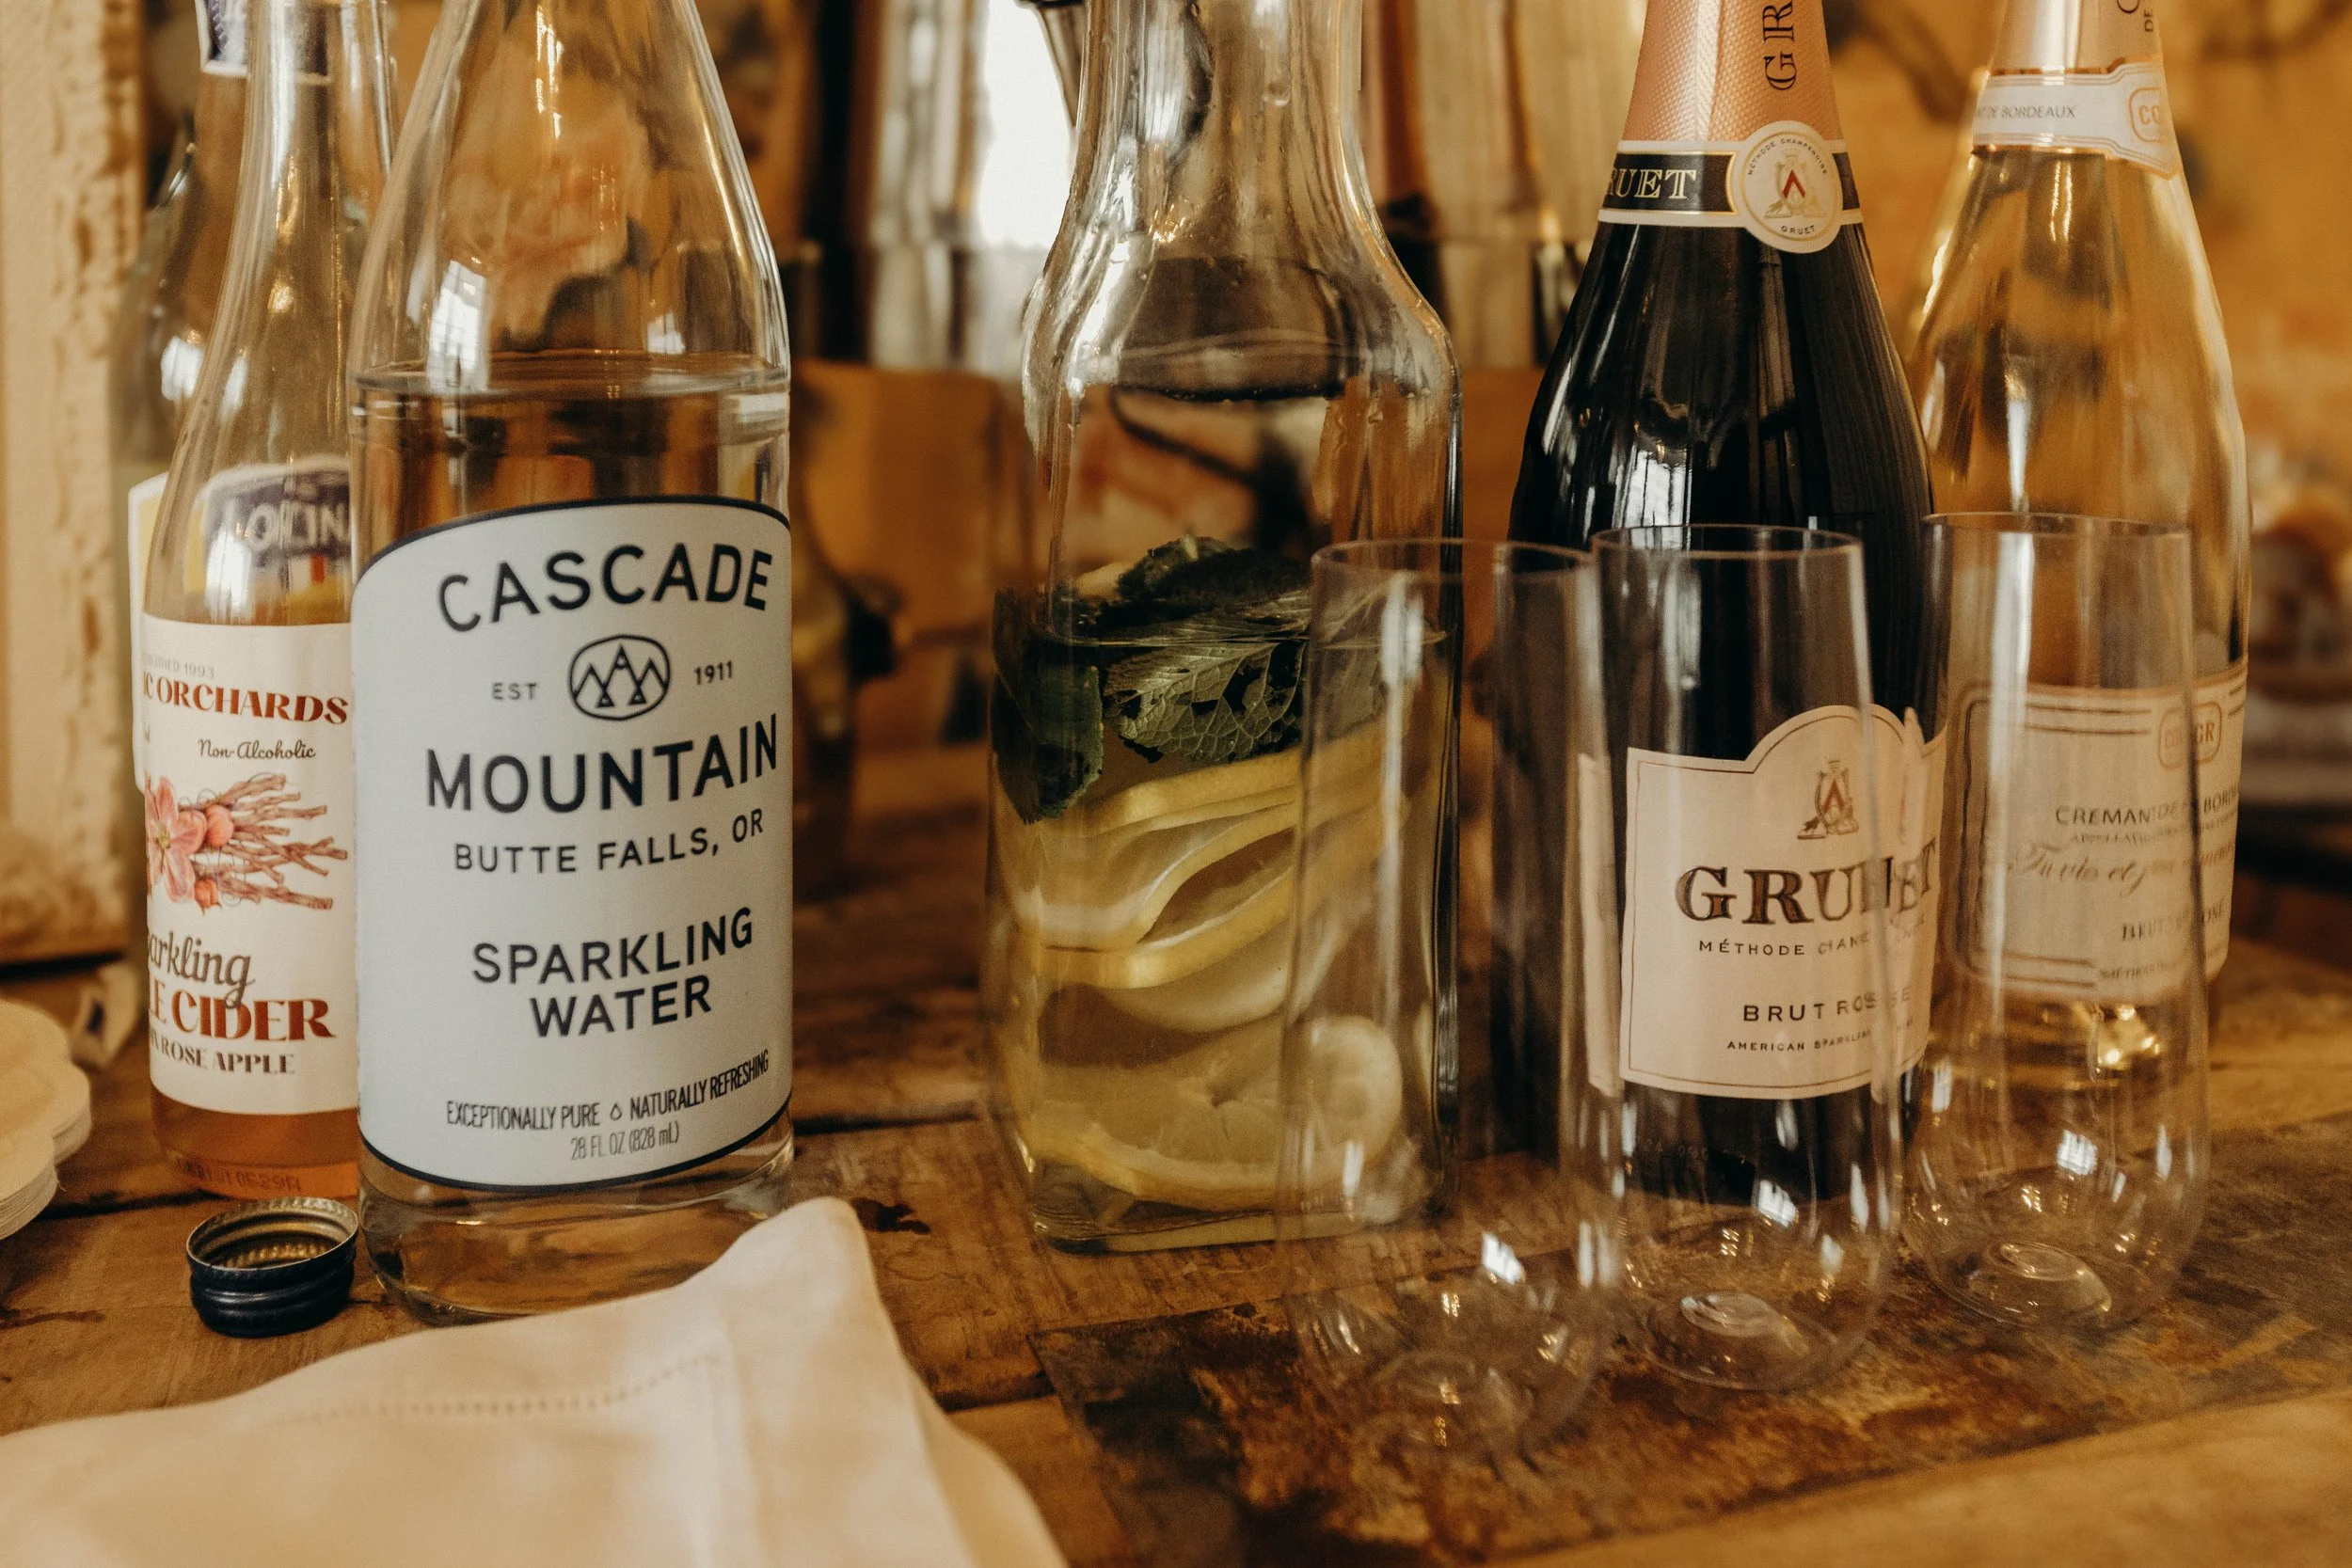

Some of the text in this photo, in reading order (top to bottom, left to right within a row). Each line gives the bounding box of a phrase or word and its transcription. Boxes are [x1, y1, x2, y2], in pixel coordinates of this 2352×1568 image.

[437, 543, 772, 632] CASCADE
[184, 661, 215, 679] 1993
[492, 661, 734, 701] EST 1911
[156, 676, 348, 724] ORCHARDS
[198, 738, 316, 760] Non-Alcoholic
[425, 713, 777, 814] MOUNTAIN
[453, 808, 763, 874] BUTTE FALLS, OR
[472, 907, 753, 985] SPARKLING
[1698, 937, 1805, 957] MÉTHODE
[171, 990, 336, 1042] CIDER
[529, 974, 711, 1037] WATER
[1743, 1003, 1825, 1022] BRUT
[161, 1035, 208, 1070] ROSE
[213, 1050, 295, 1075] APPLE
[1726, 1040, 1805, 1053] AMERICAN
[446, 1048, 770, 1131] EXCEPTIONALLY PURE NATURALLY REFRESHING
[570, 1120, 680, 1162] 28 FL OZ (828 mL)
